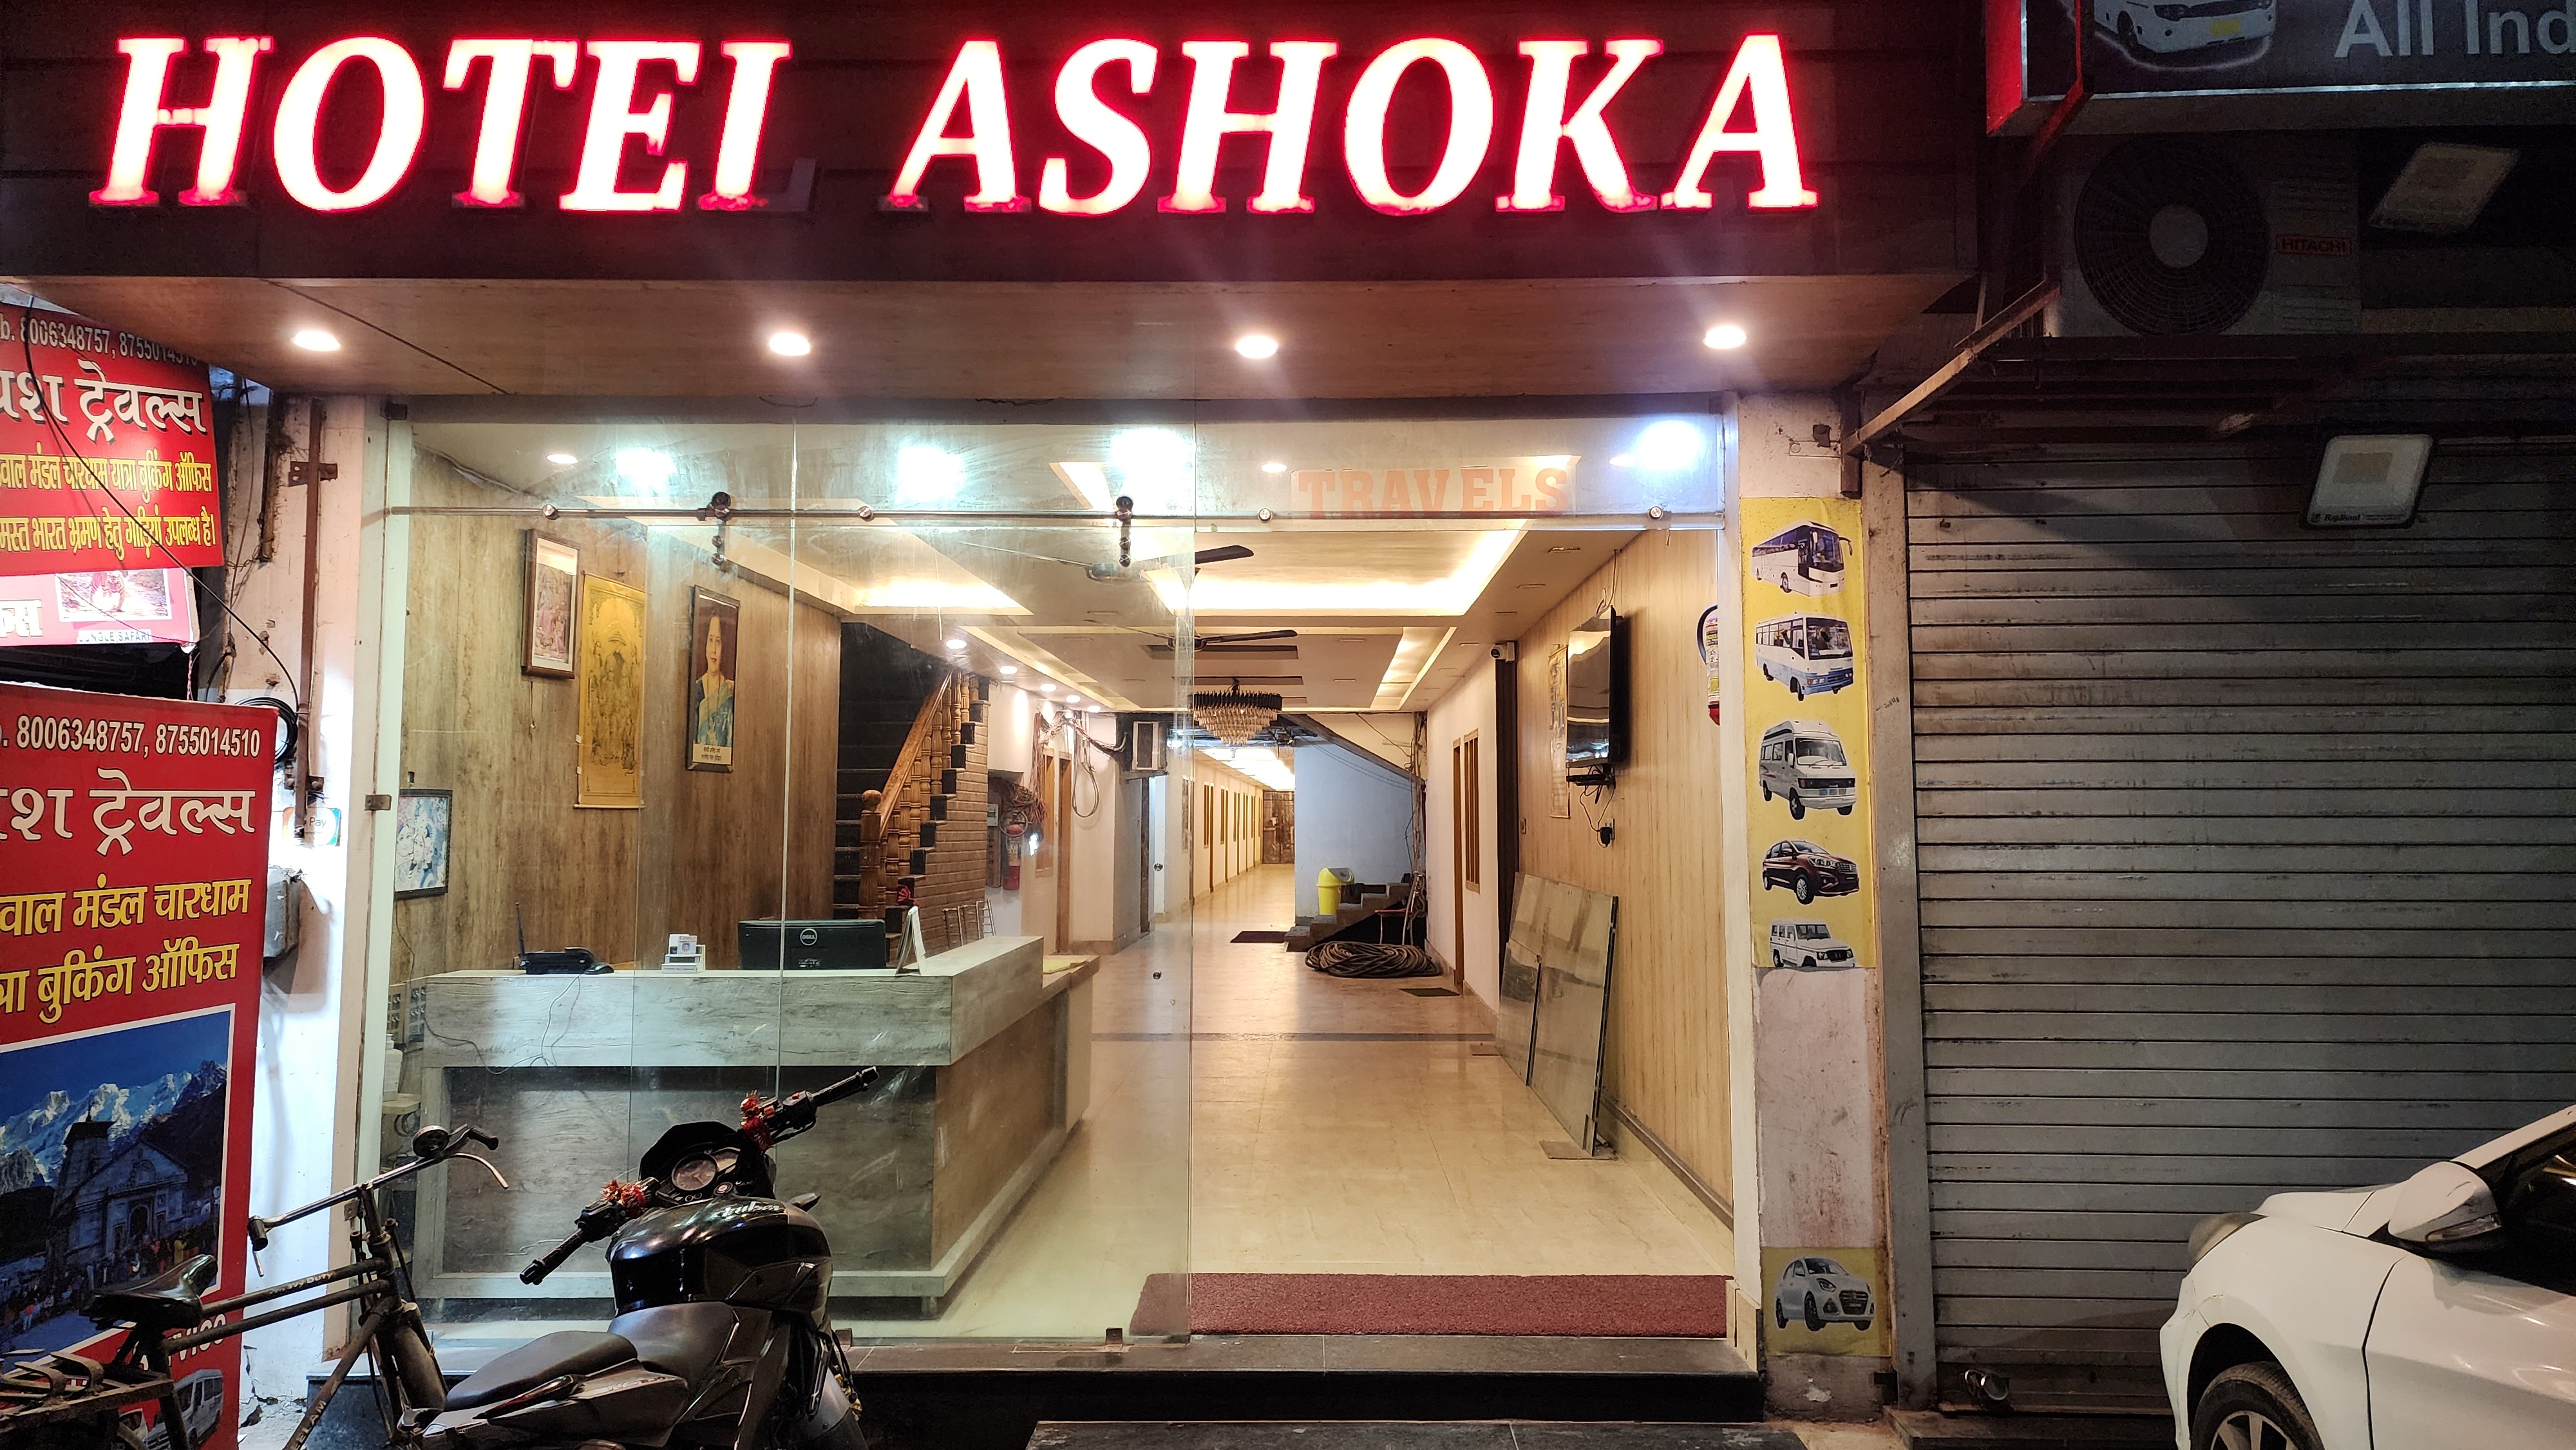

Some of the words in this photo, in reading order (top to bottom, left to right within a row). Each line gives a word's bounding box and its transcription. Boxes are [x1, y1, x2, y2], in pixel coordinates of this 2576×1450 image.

[2334, 0, 2434, 57] All
[878, 32, 1819, 216] ASHOKA
[28, 441, 62, 490] मंडल
[109, 458, 137, 491] यात्रा
[1298, 467, 1567, 518] TRAVELS
[32, 517, 67, 551] भारत
[118, 631, 151, 641] SAFARI
[17, 715, 149, 758] 8006348757,
[155, 725, 260, 757] 8755014510
[73, 873, 147, 928] मंडल
[155, 879, 251, 920] चारधाम
[37, 945, 136, 1024] बुकिंग
[142, 936, 240, 990] ऑफिस
